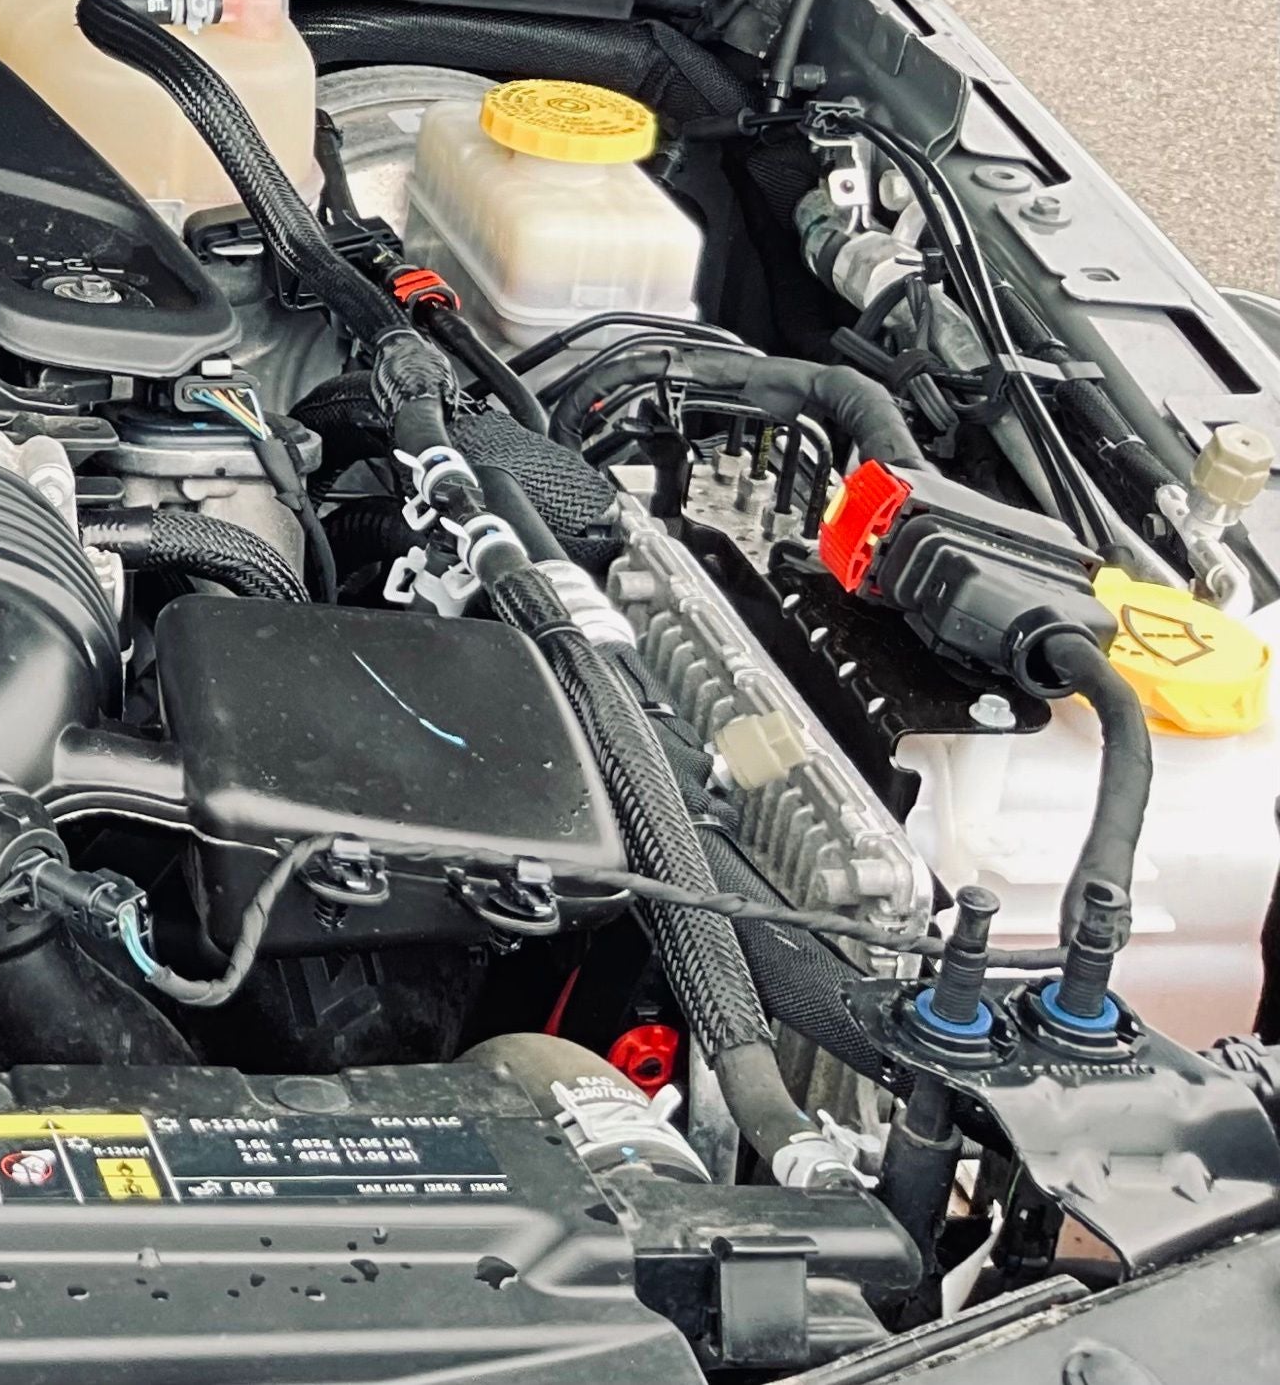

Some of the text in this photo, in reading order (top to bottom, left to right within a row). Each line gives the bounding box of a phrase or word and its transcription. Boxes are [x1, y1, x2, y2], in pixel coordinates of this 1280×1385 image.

[576, 1076, 615, 1087] RAD
[189, 1118, 280, 1133] R-1234yf
[371, 1117, 462, 1128] FCA US LLC
[234, 1138, 271, 1150] 3.6L
[339, 1137, 382, 1149] (1.06
[383, 1137, 412, 1149] Lb)
[240, 1151, 278, 1164] 2.0L
[345, 1150, 390, 1164] (1.06
[391, 1150, 420, 1164] Lb)
[230, 1181, 276, 1196] PAG
